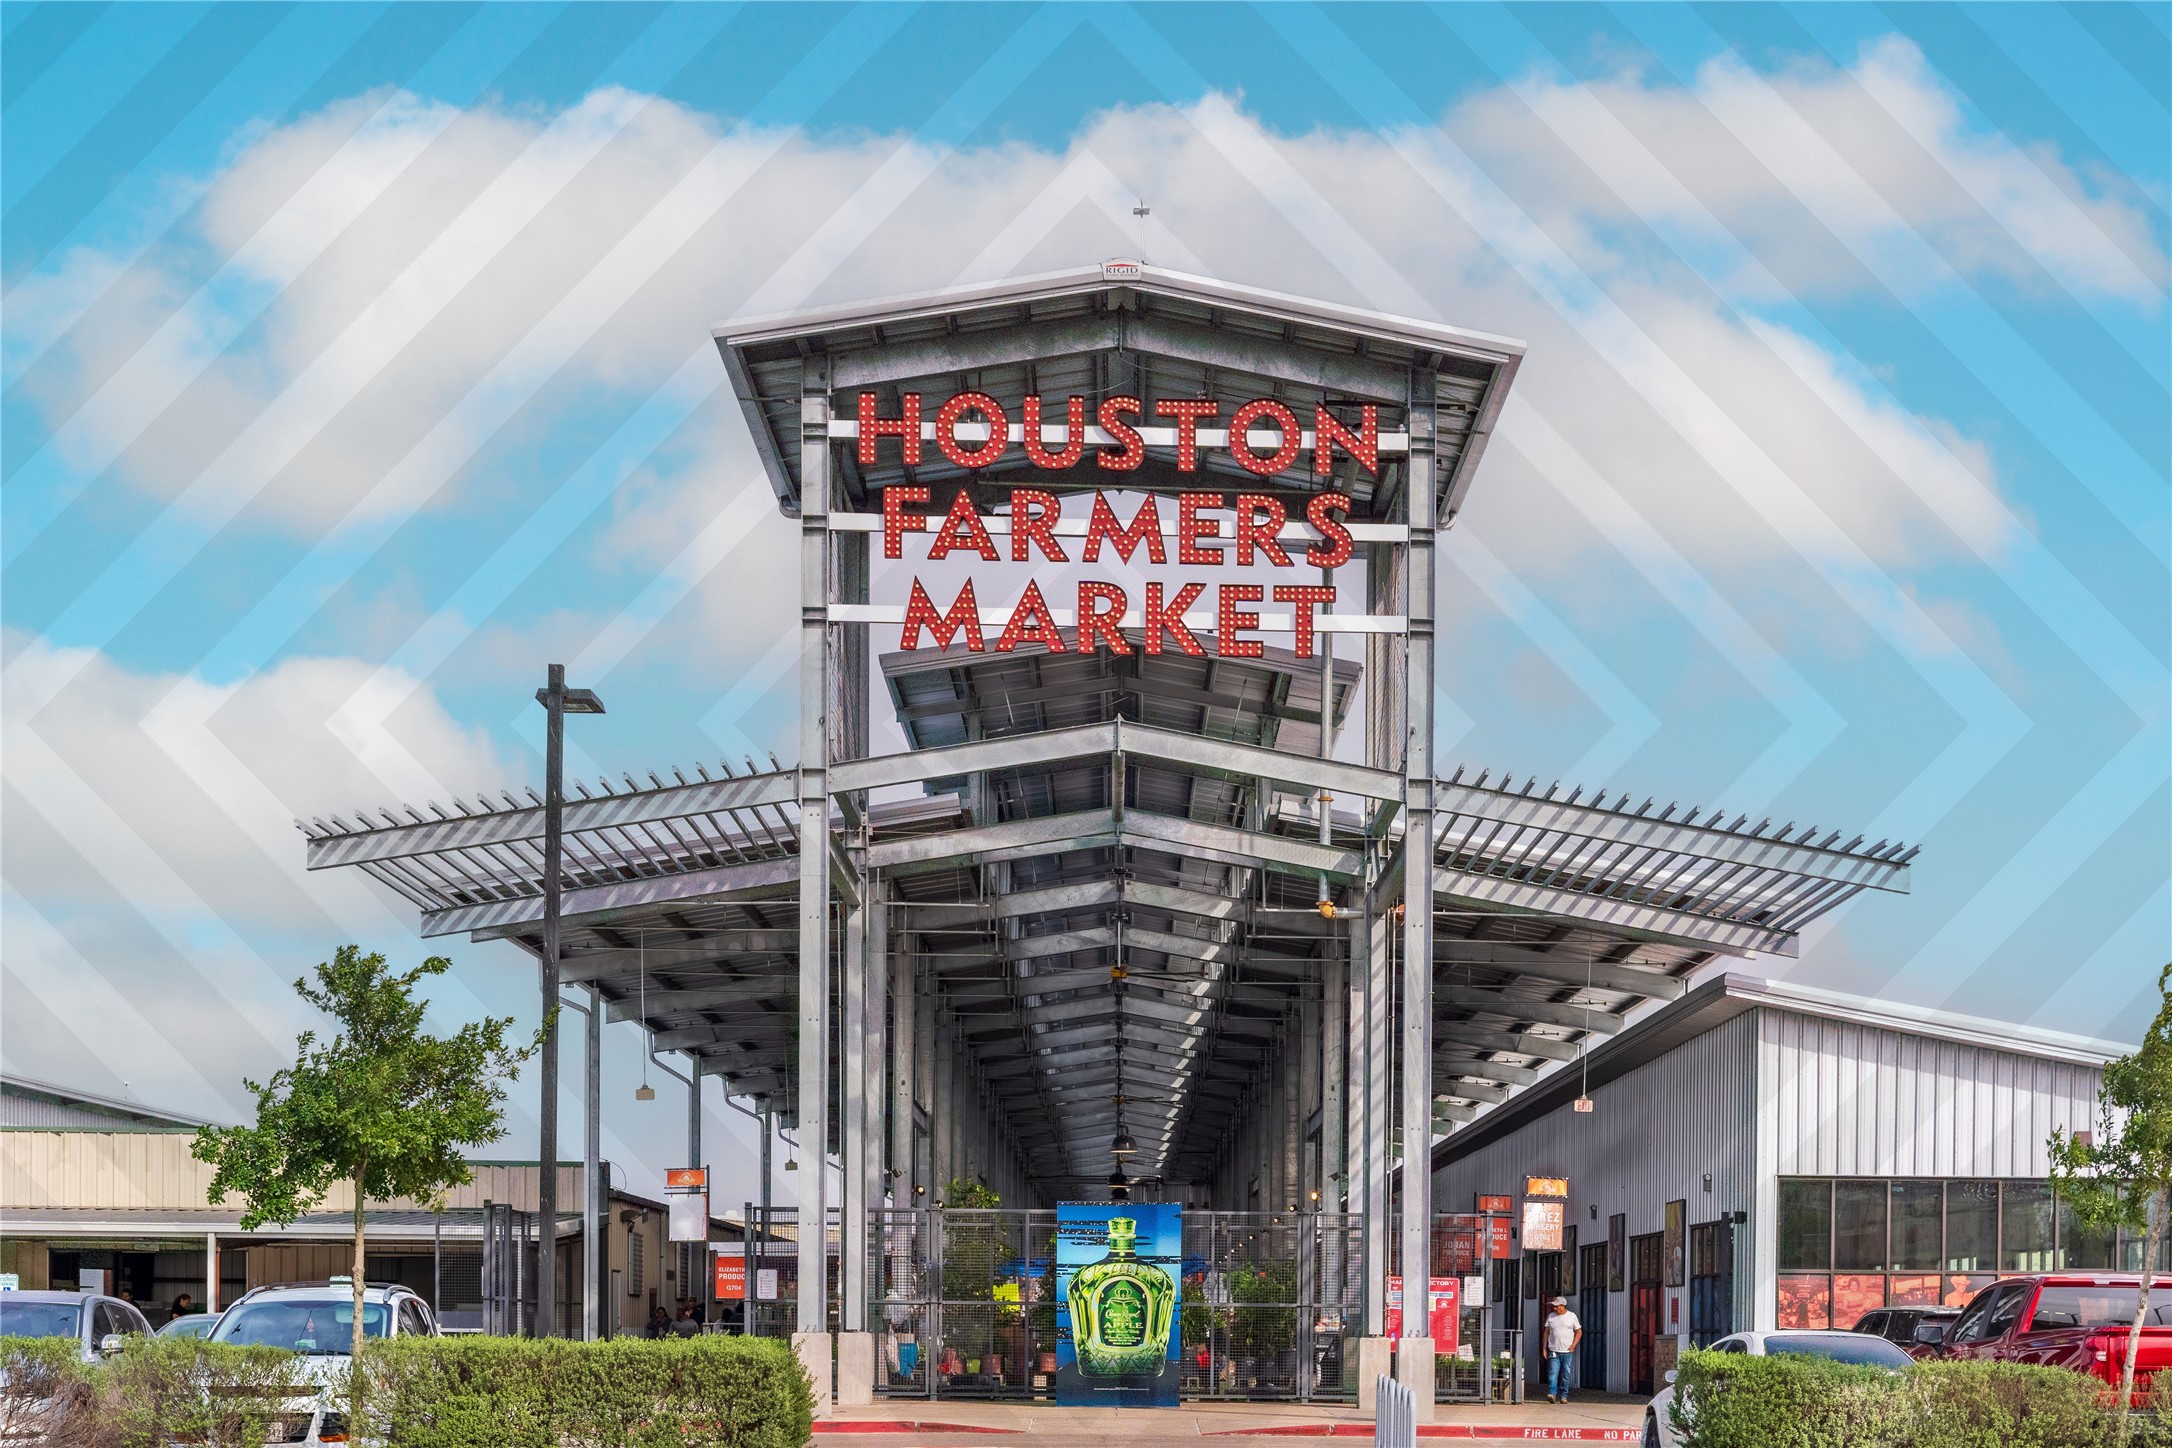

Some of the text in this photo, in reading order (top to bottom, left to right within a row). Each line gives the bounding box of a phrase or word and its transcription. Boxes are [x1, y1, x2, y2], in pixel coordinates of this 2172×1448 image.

[858, 391, 1379, 477] HOUSTON
[883, 485, 1354, 569] FARMERS
[899, 576, 1337, 659] MARKET
[1524, 1428, 1582, 1439] FIRE LANE
[1604, 1430, 1618, 1440] NO
